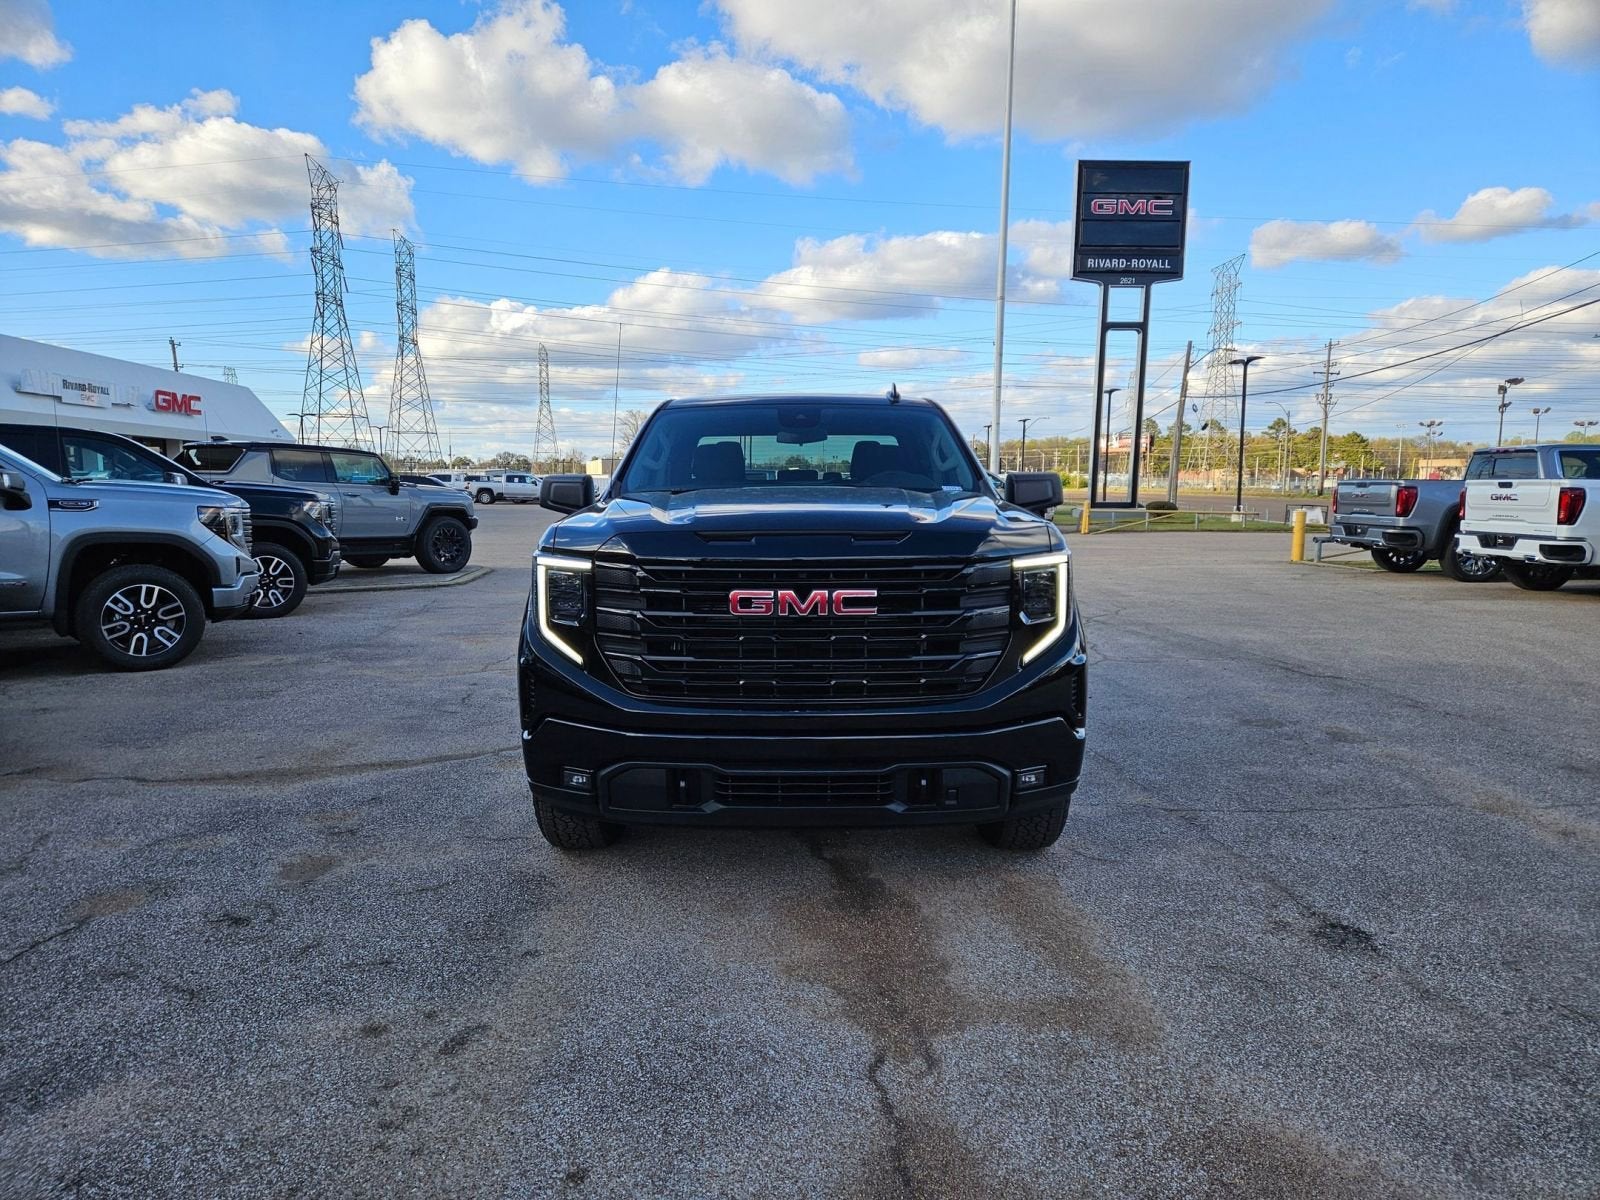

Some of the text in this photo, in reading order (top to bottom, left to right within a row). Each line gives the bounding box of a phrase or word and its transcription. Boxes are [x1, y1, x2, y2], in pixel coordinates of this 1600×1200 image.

[1091, 199, 1173, 215] GMC
[1087, 258, 1171, 269] RIVARD-ROYALL
[153, 389, 202, 416] GMC
[1491, 493, 1518, 501] GMC
[729, 590, 878, 615] GMC
